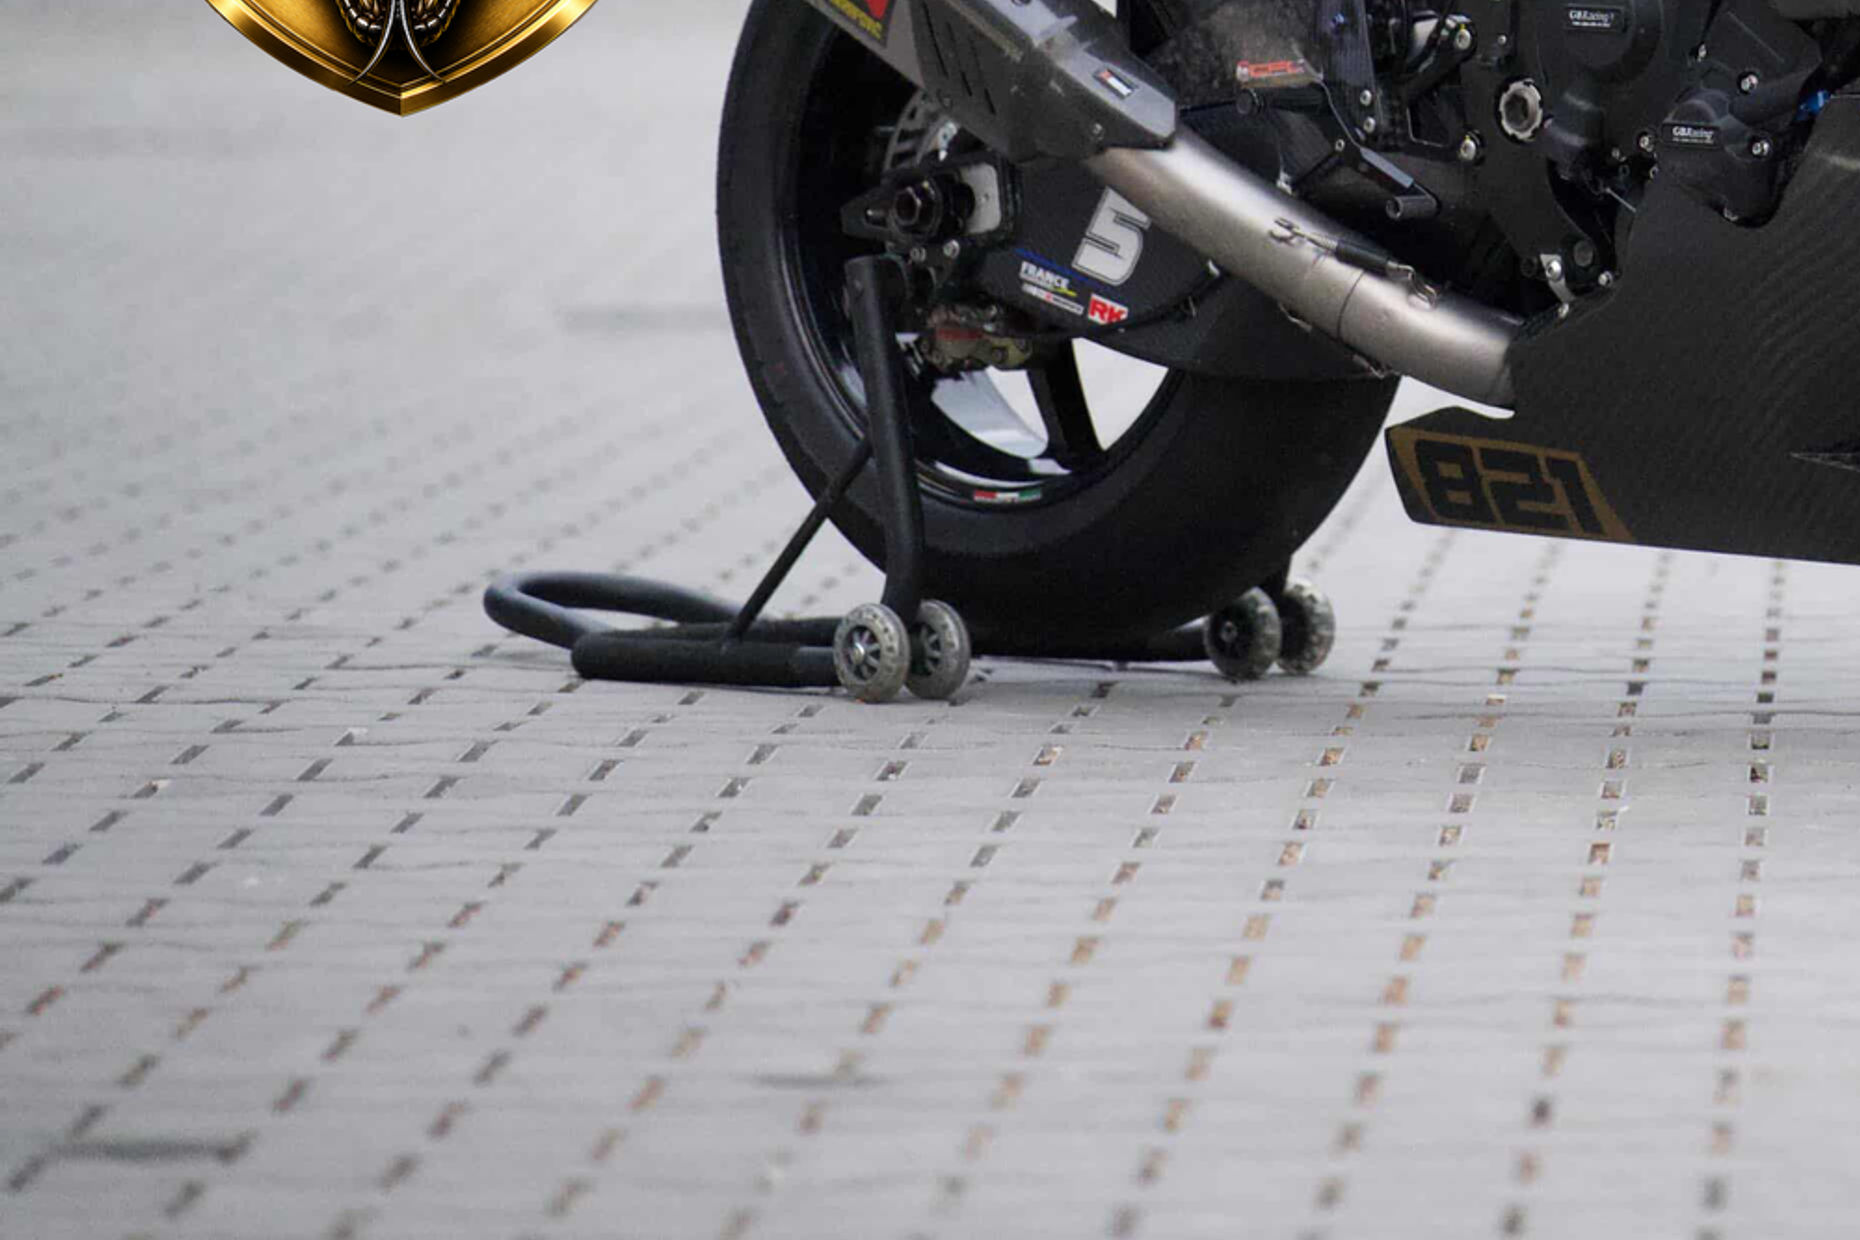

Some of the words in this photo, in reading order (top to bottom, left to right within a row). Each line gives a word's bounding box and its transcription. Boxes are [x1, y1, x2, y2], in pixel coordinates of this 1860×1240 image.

[1070, 185, 1151, 286] 5
[1090, 296, 1128, 324] RK
[1413, 438, 1606, 537] 821
